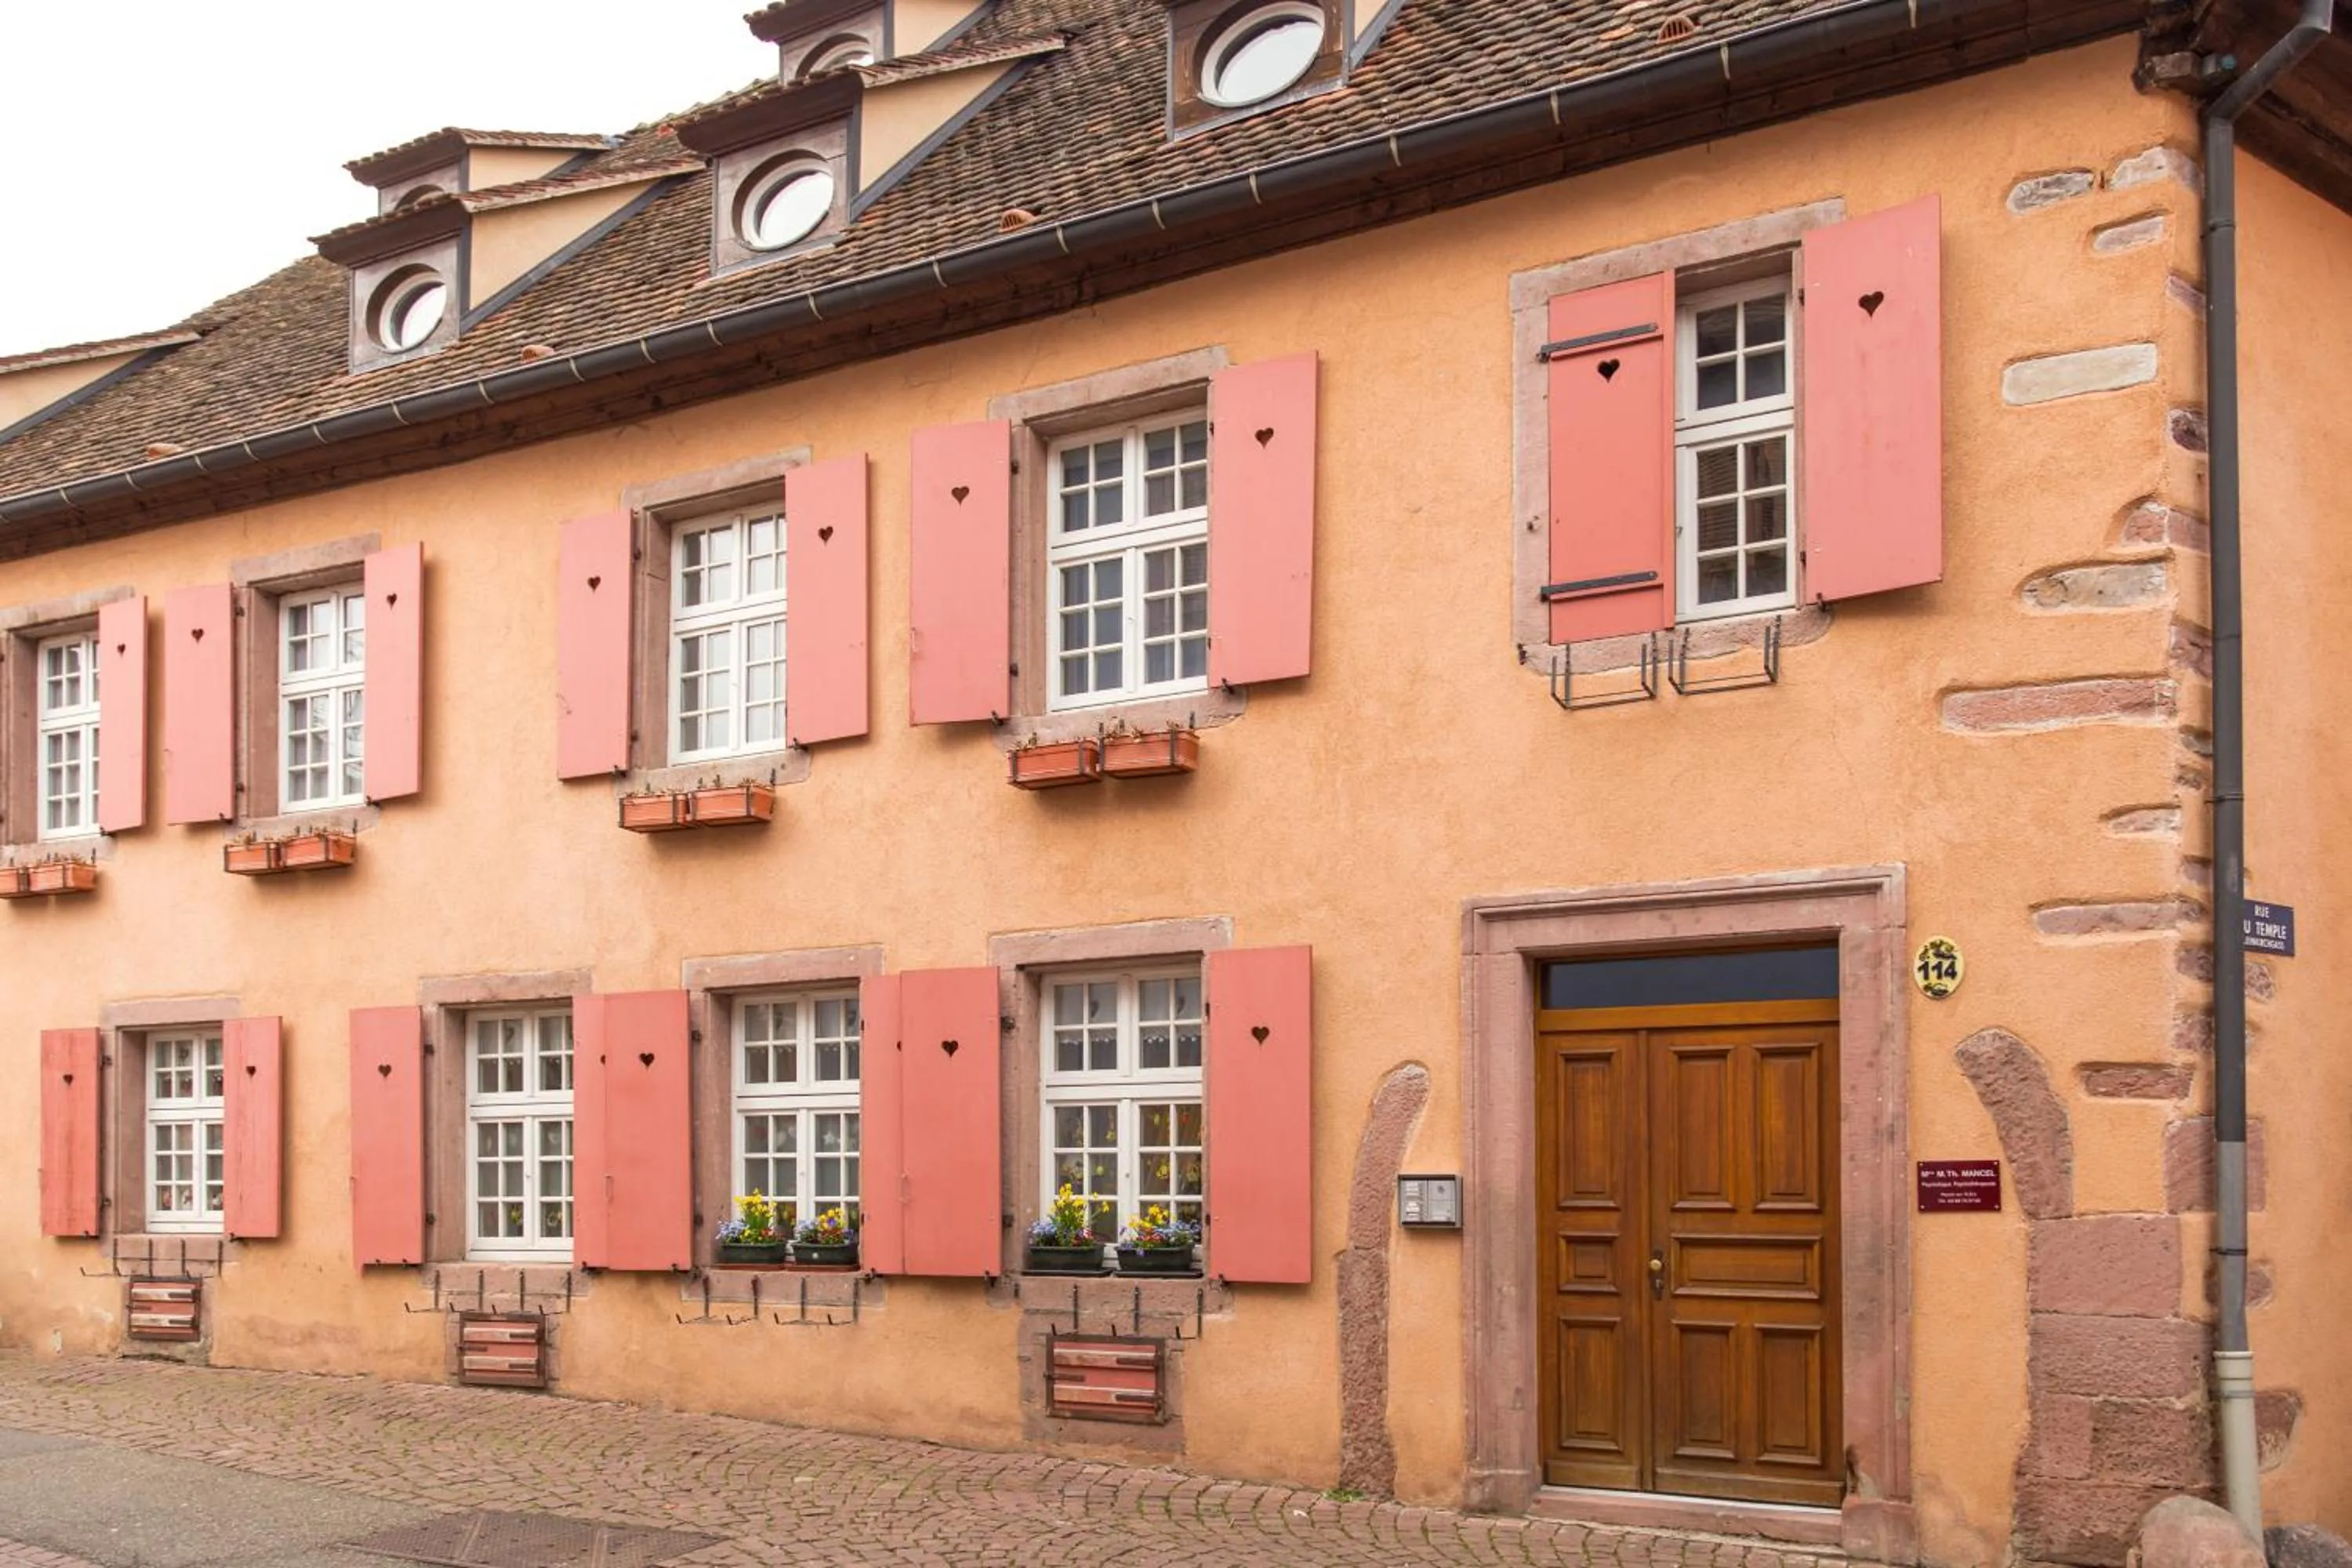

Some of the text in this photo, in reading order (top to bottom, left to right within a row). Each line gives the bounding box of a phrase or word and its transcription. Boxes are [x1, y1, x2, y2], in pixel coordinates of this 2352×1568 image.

[2254, 903, 2270, 919] RUE
[2243, 919, 2287, 940] U TEMPLE
[1917, 960, 1958, 981] 114
